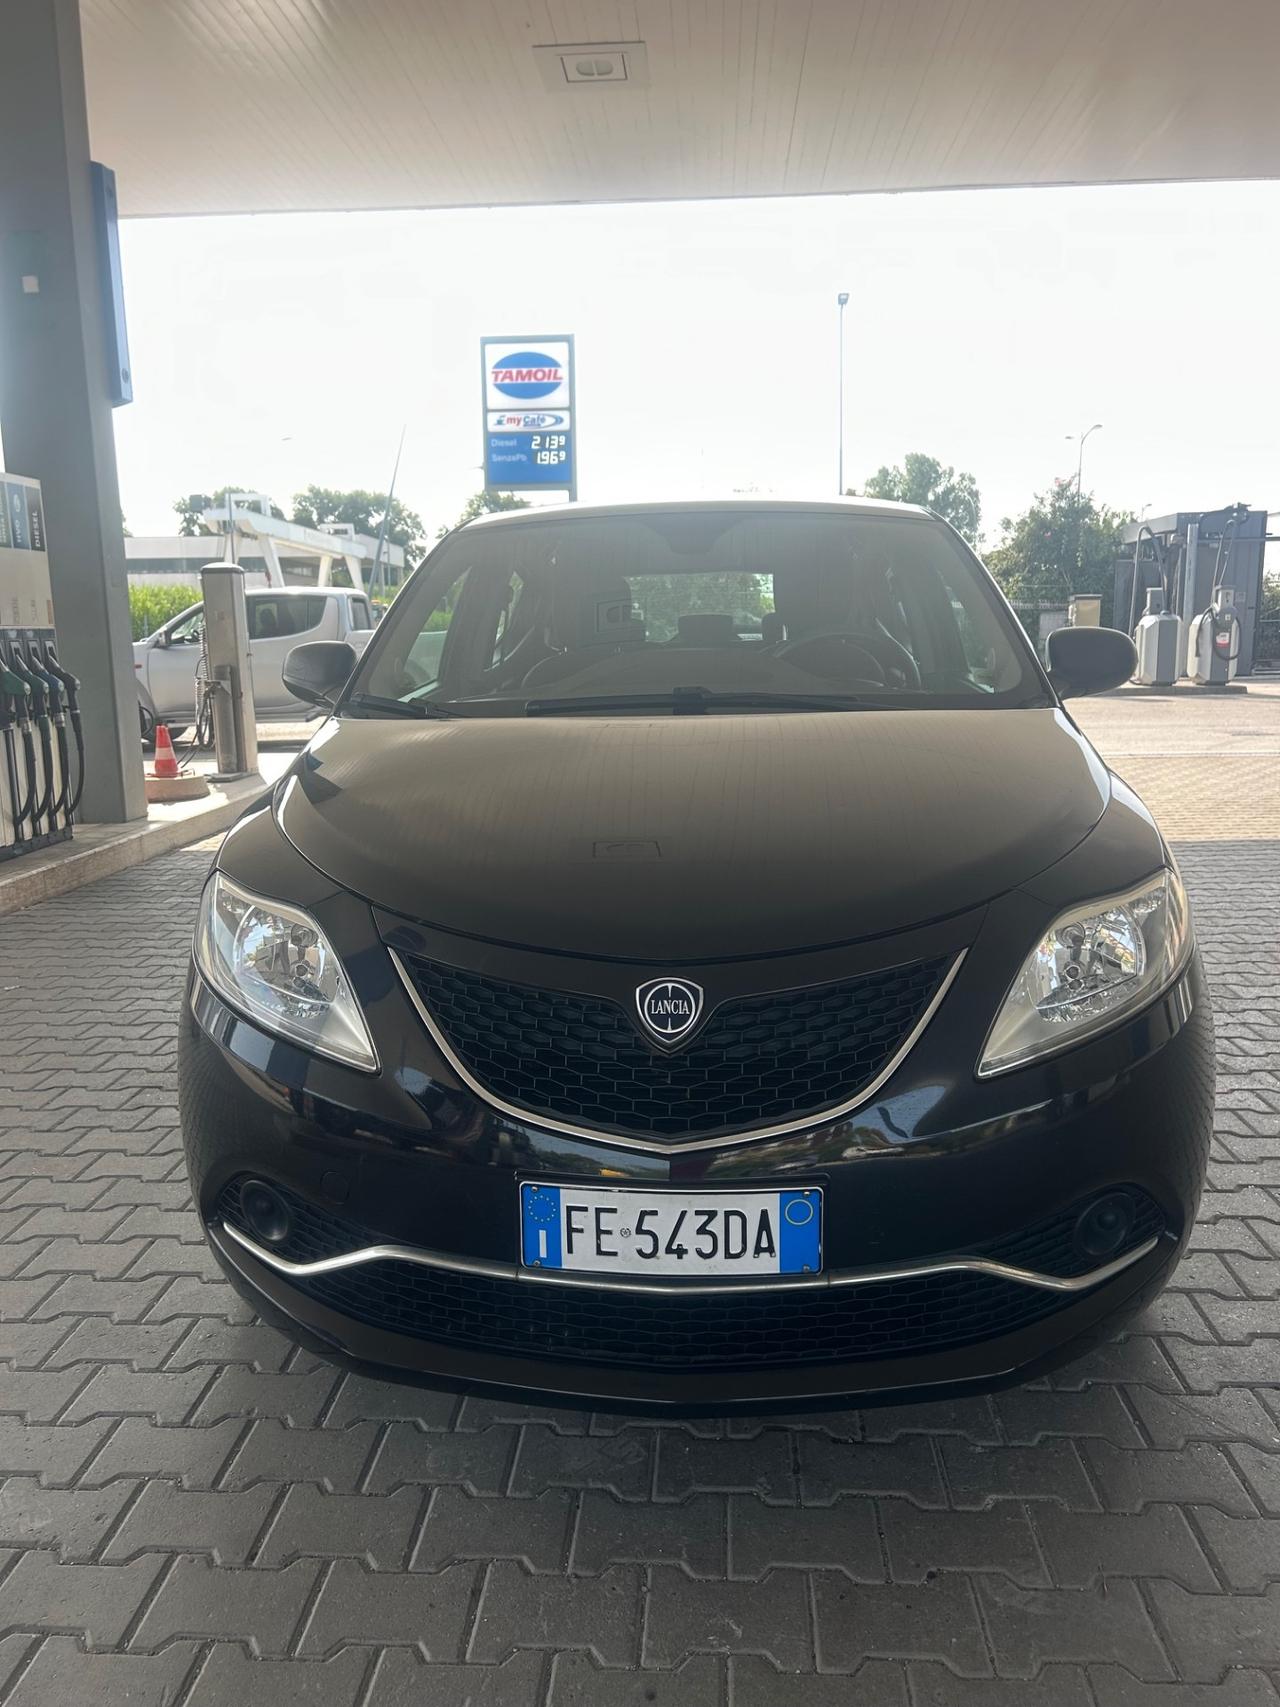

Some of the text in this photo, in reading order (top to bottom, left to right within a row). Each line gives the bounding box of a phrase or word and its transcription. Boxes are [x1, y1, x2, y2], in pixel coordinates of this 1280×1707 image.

[491, 369, 563, 382] TAMOIL
[32, 511, 41, 547] DIESEL
[650, 999, 690, 1015] LANCIA
